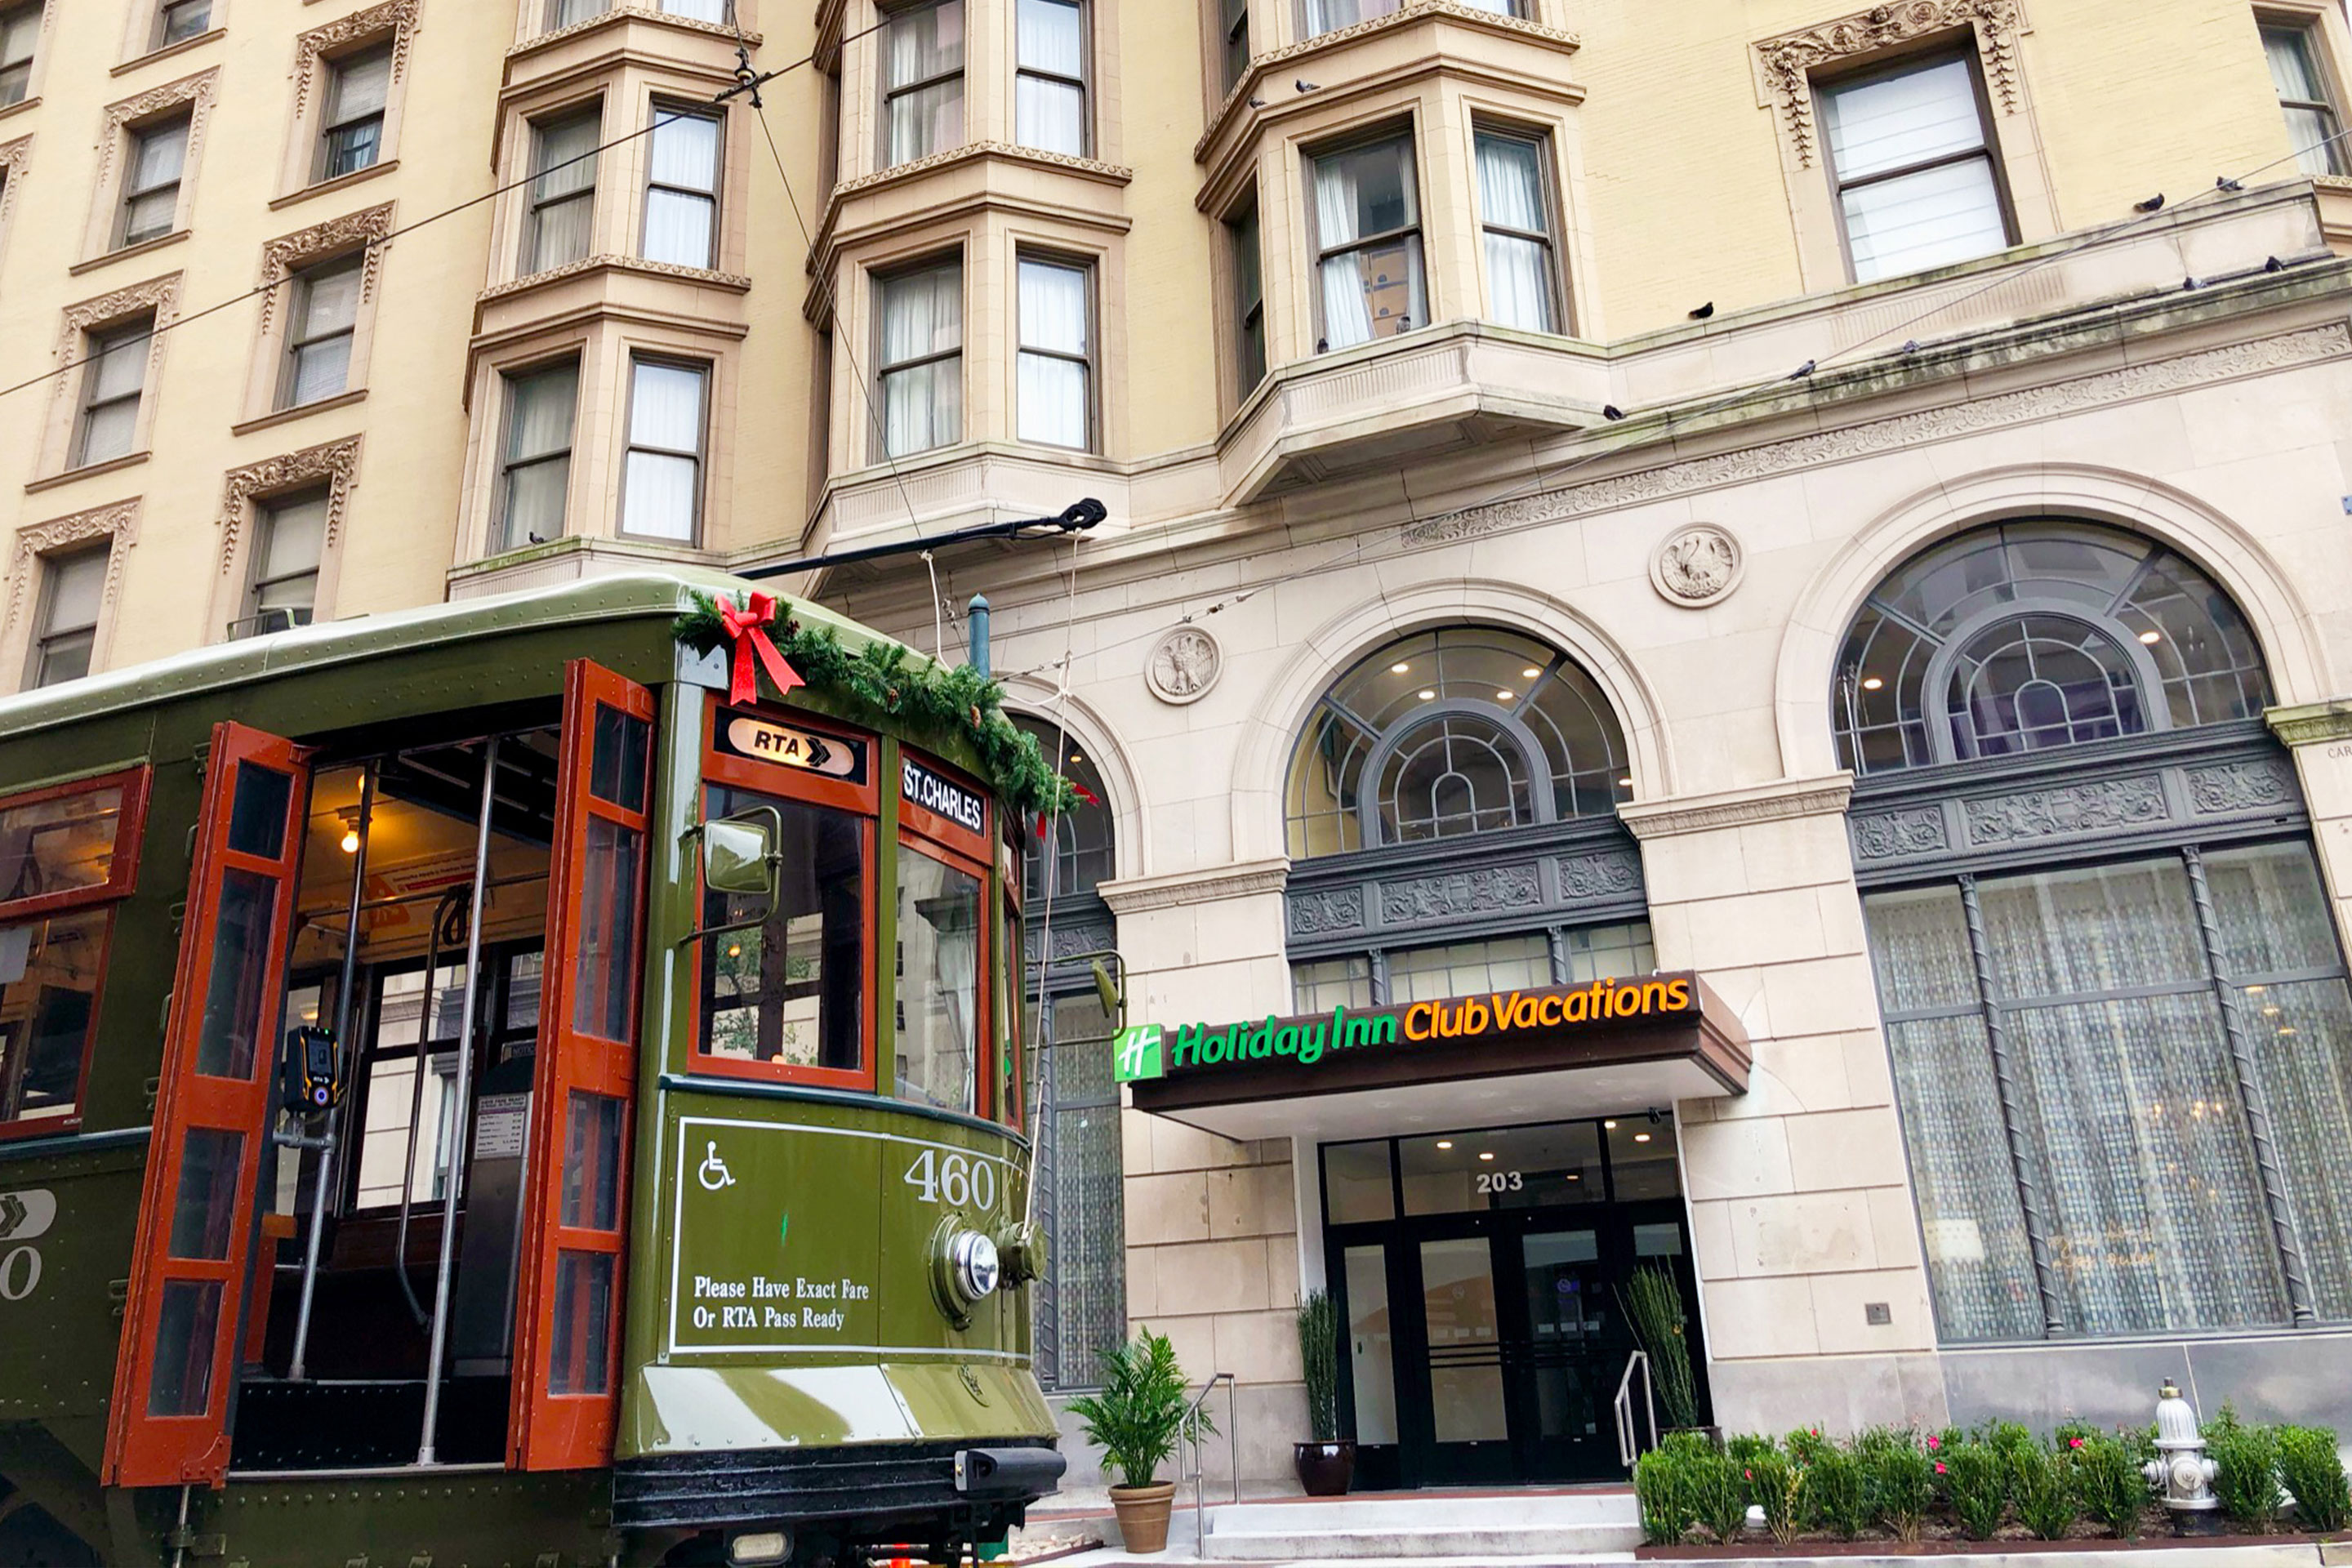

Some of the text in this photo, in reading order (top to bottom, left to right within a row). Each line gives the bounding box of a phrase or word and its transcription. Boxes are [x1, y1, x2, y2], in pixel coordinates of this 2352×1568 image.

[754, 730, 799, 757] RTA
[1171, 976, 1690, 1065] Holiday Inn Club Vacations
[904, 1150, 995, 1211] 460
[1477, 1171, 1523, 1193] 203
[694, 1276, 870, 1299] Please Have Exact Fare
[693, 1306, 844, 1331] Or RTA Pass Ready
